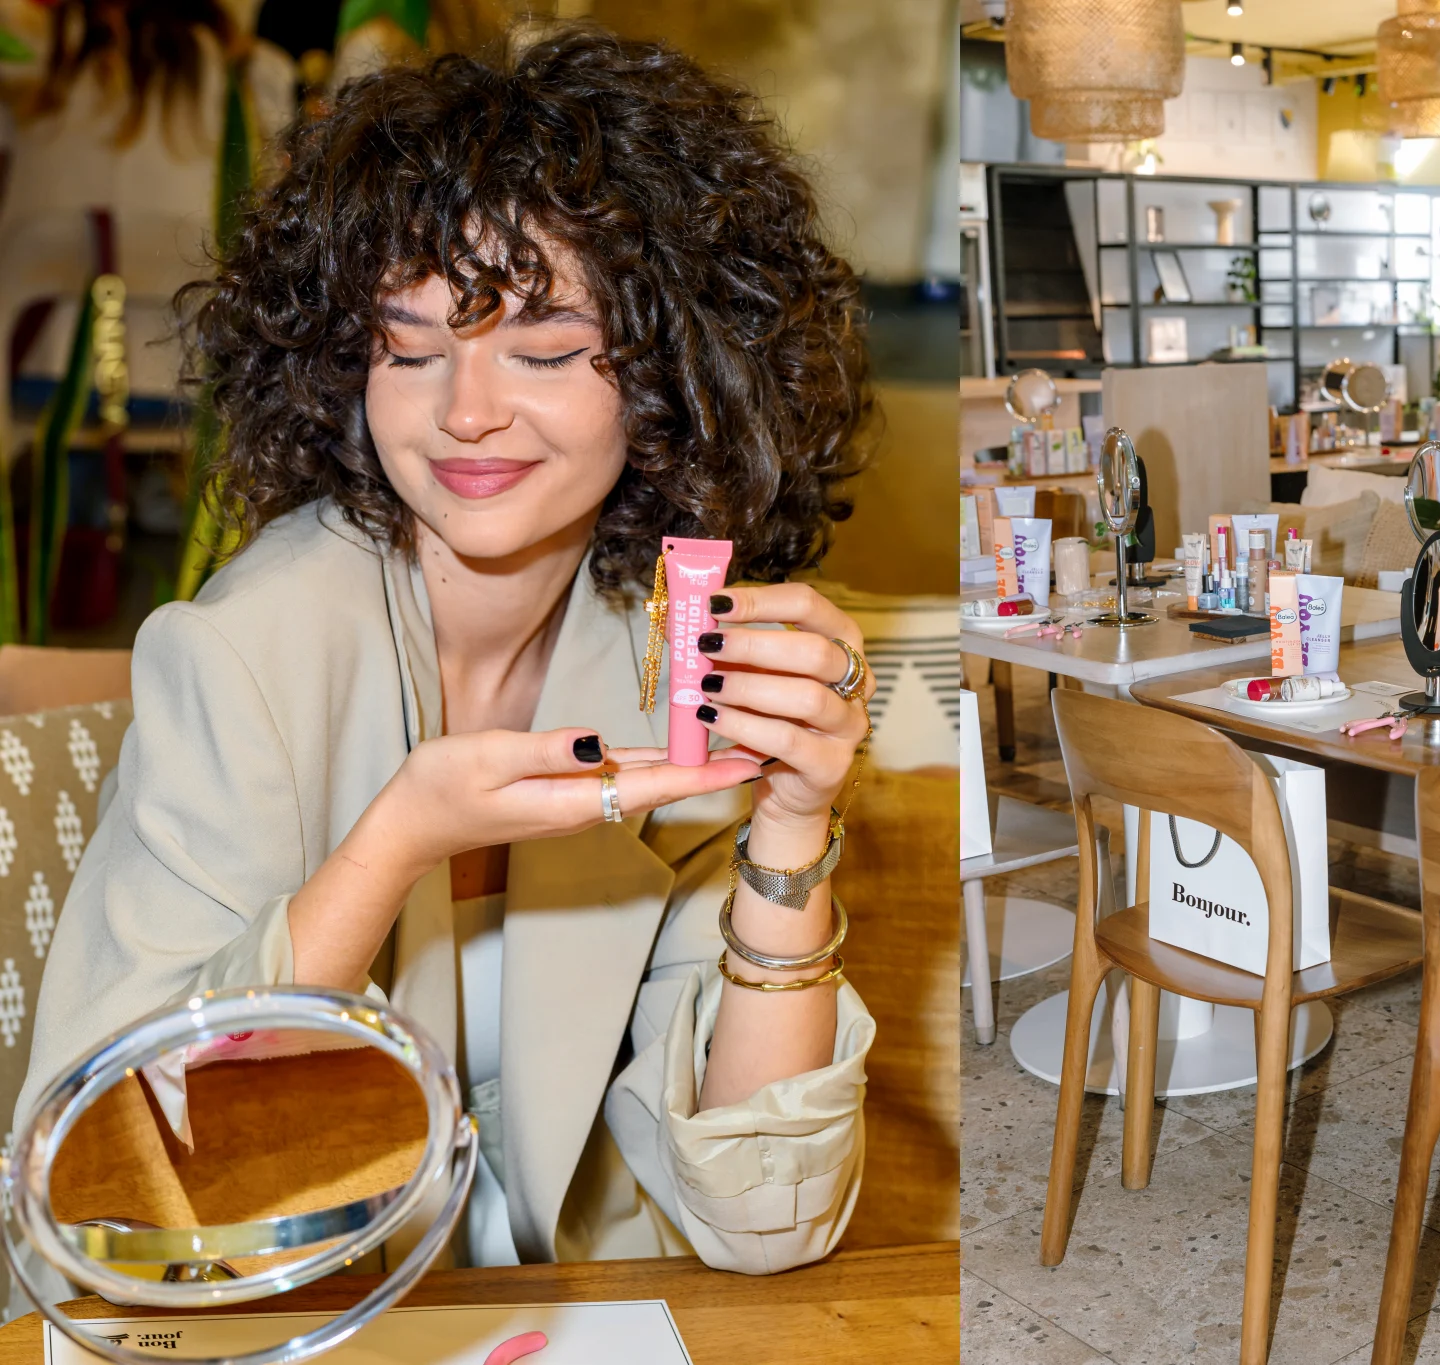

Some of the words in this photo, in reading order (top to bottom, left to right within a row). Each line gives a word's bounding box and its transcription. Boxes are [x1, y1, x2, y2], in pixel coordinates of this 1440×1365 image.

[1298, 594, 1313, 633] YOU
[1308, 603, 1324, 611] Balea
[674, 600, 687, 662] POWER
[686, 594, 701, 669] PEPTIDE
[688, 694, 700, 702] 30
[1171, 881, 1251, 927] Bonjour.
[137, 1330, 184, 1340] jour.
[138, 1340, 178, 1349] Bon
